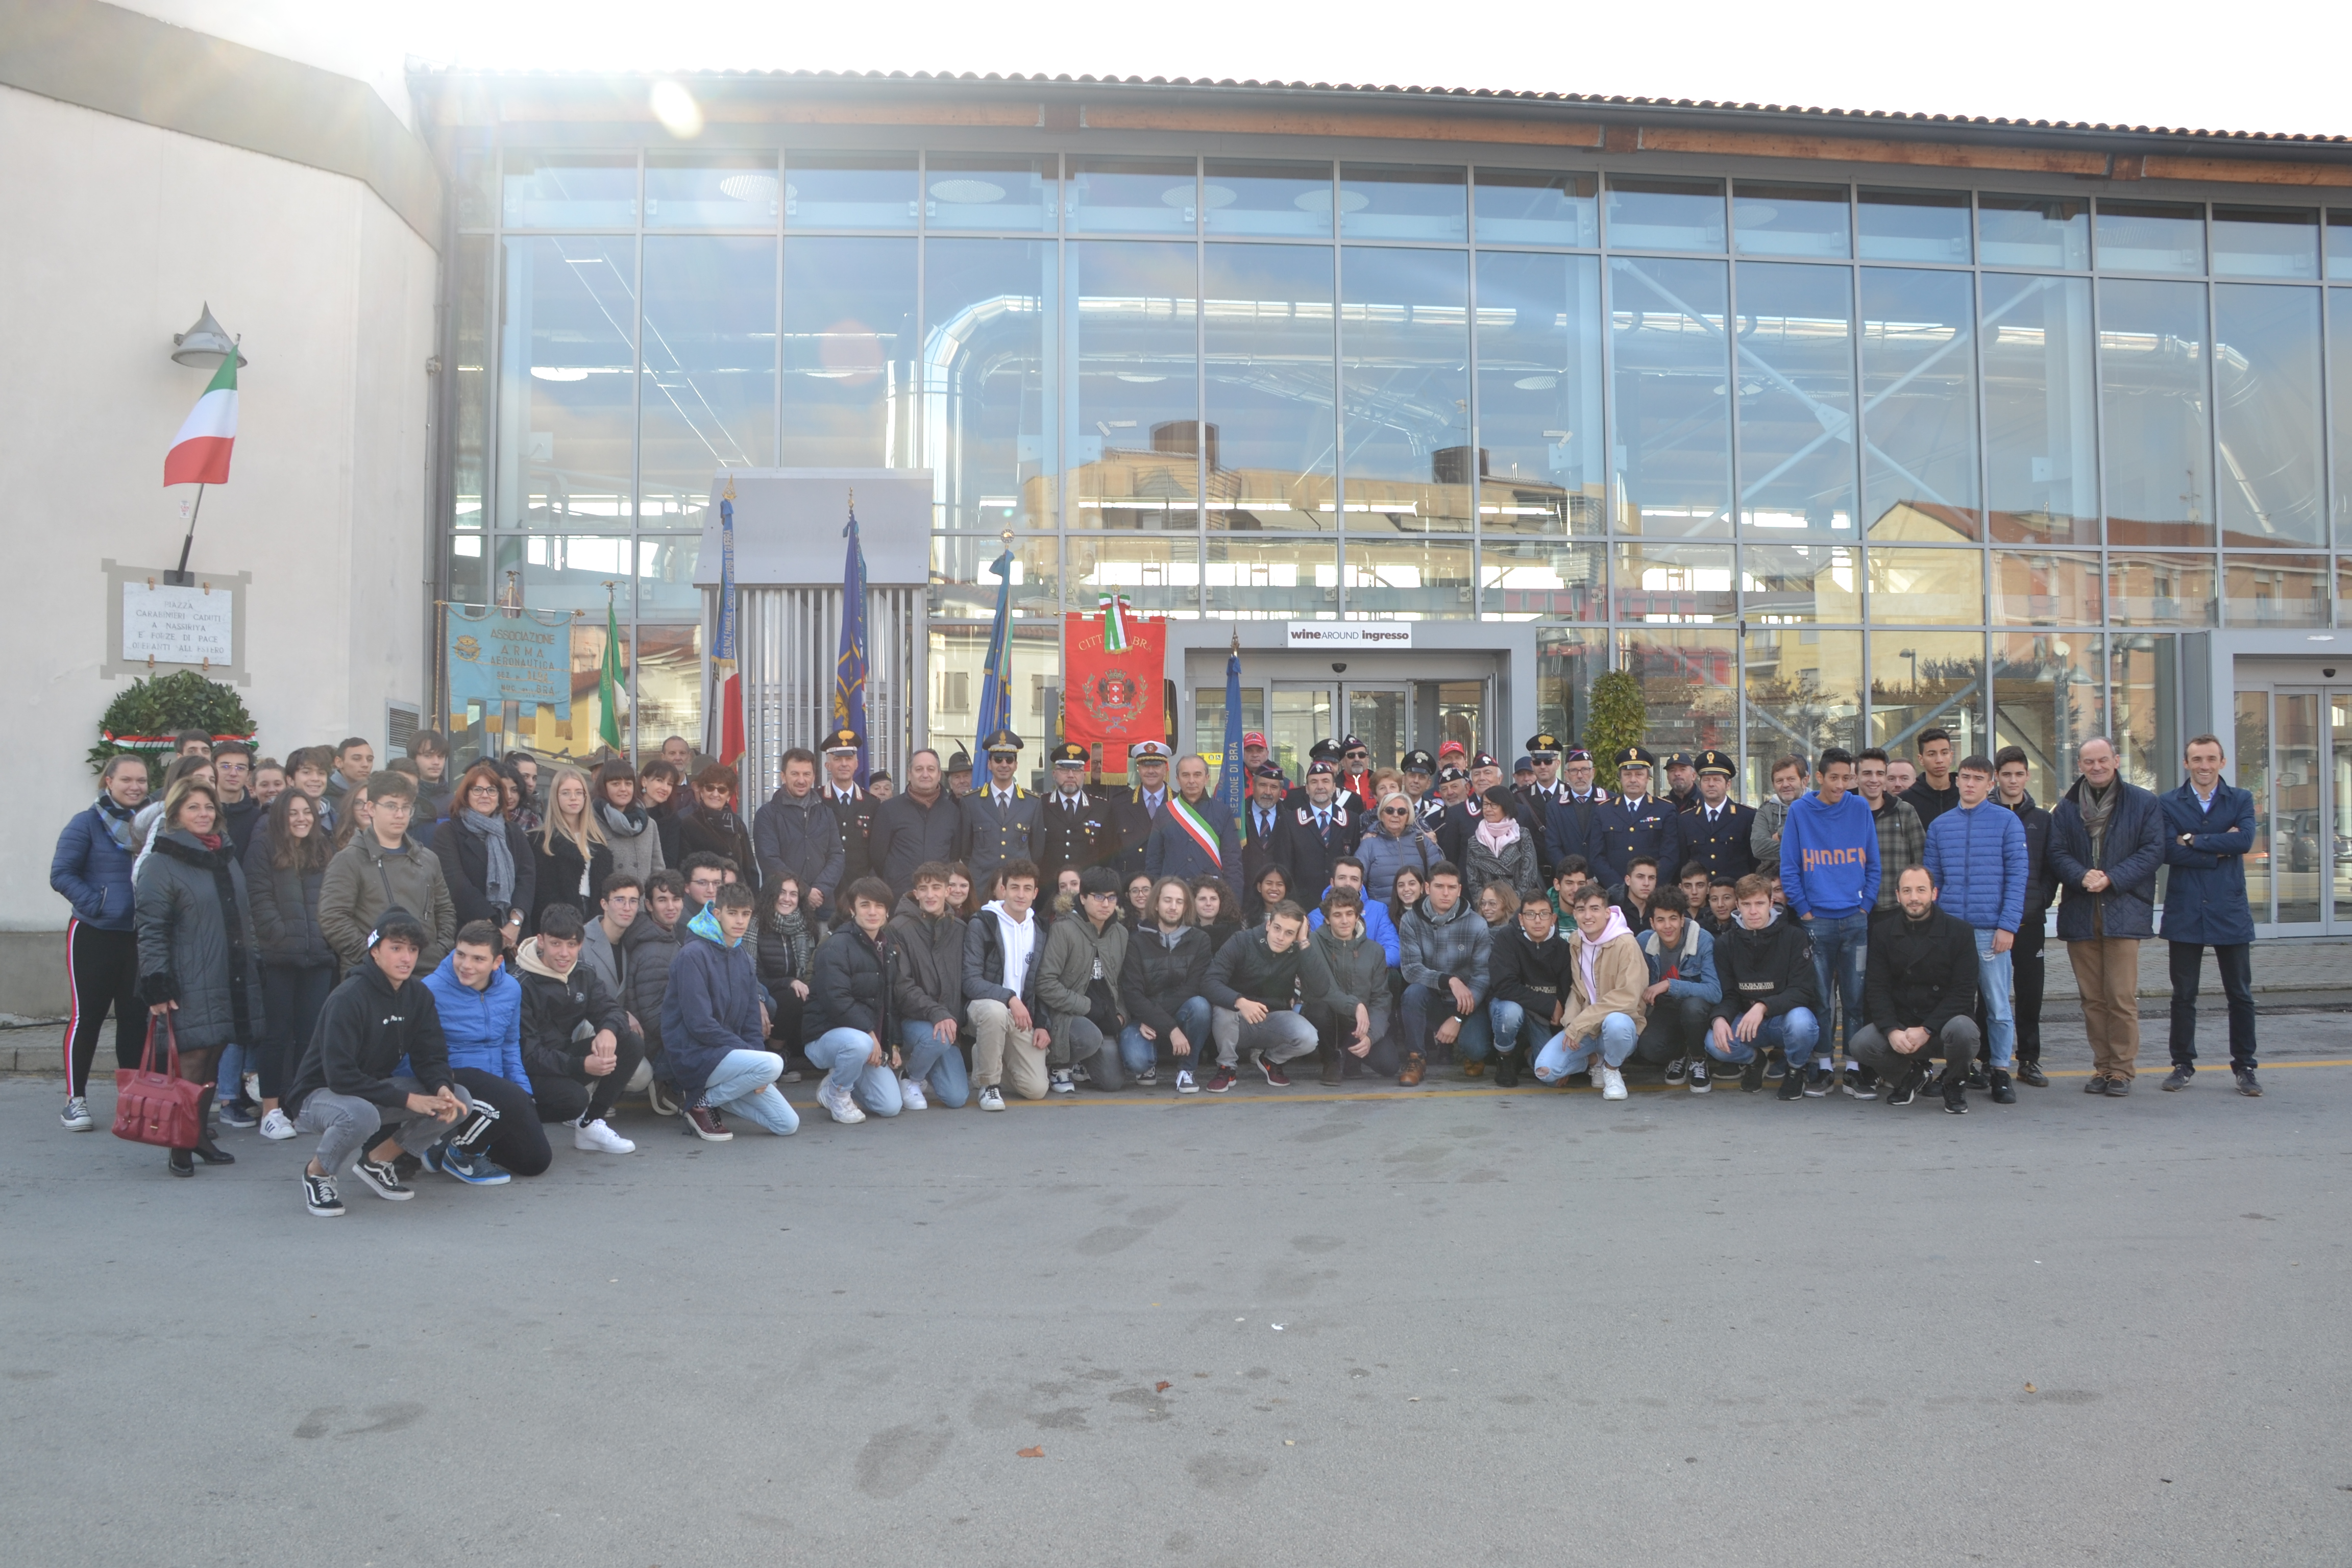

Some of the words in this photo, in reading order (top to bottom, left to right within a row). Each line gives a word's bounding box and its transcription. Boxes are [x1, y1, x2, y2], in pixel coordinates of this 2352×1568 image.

[723, 529, 733, 552] GUERRA
[725, 559, 733, 583] DISPERSI
[164, 601, 193, 609] PIAZZA
[136, 609, 185, 620] CARABINIERI
[193, 614, 221, 622] CADUTI
[166, 622, 206, 632] NASSIRIYA
[151, 632, 176, 640] FORZE
[198, 635, 218, 643] PACE
[490, 628, 556, 645] ASSOCIAZIONE
[1079, 633, 1103, 651] CITT
[1361, 630, 1409, 642] ingresso
[1132, 635, 1152, 653] BRA
[500, 645, 544, 658] ARMA
[490, 657, 555, 670] AERONAUTICA
[527, 670, 548, 683] ALBA
[536, 684, 555, 695] BRA
[1229, 741, 1239, 761] BRA
[1229, 764, 1239, 773] DI
[1229, 776, 1239, 814] SEZIONE
[1802, 847, 1867, 872] HIDDEN
